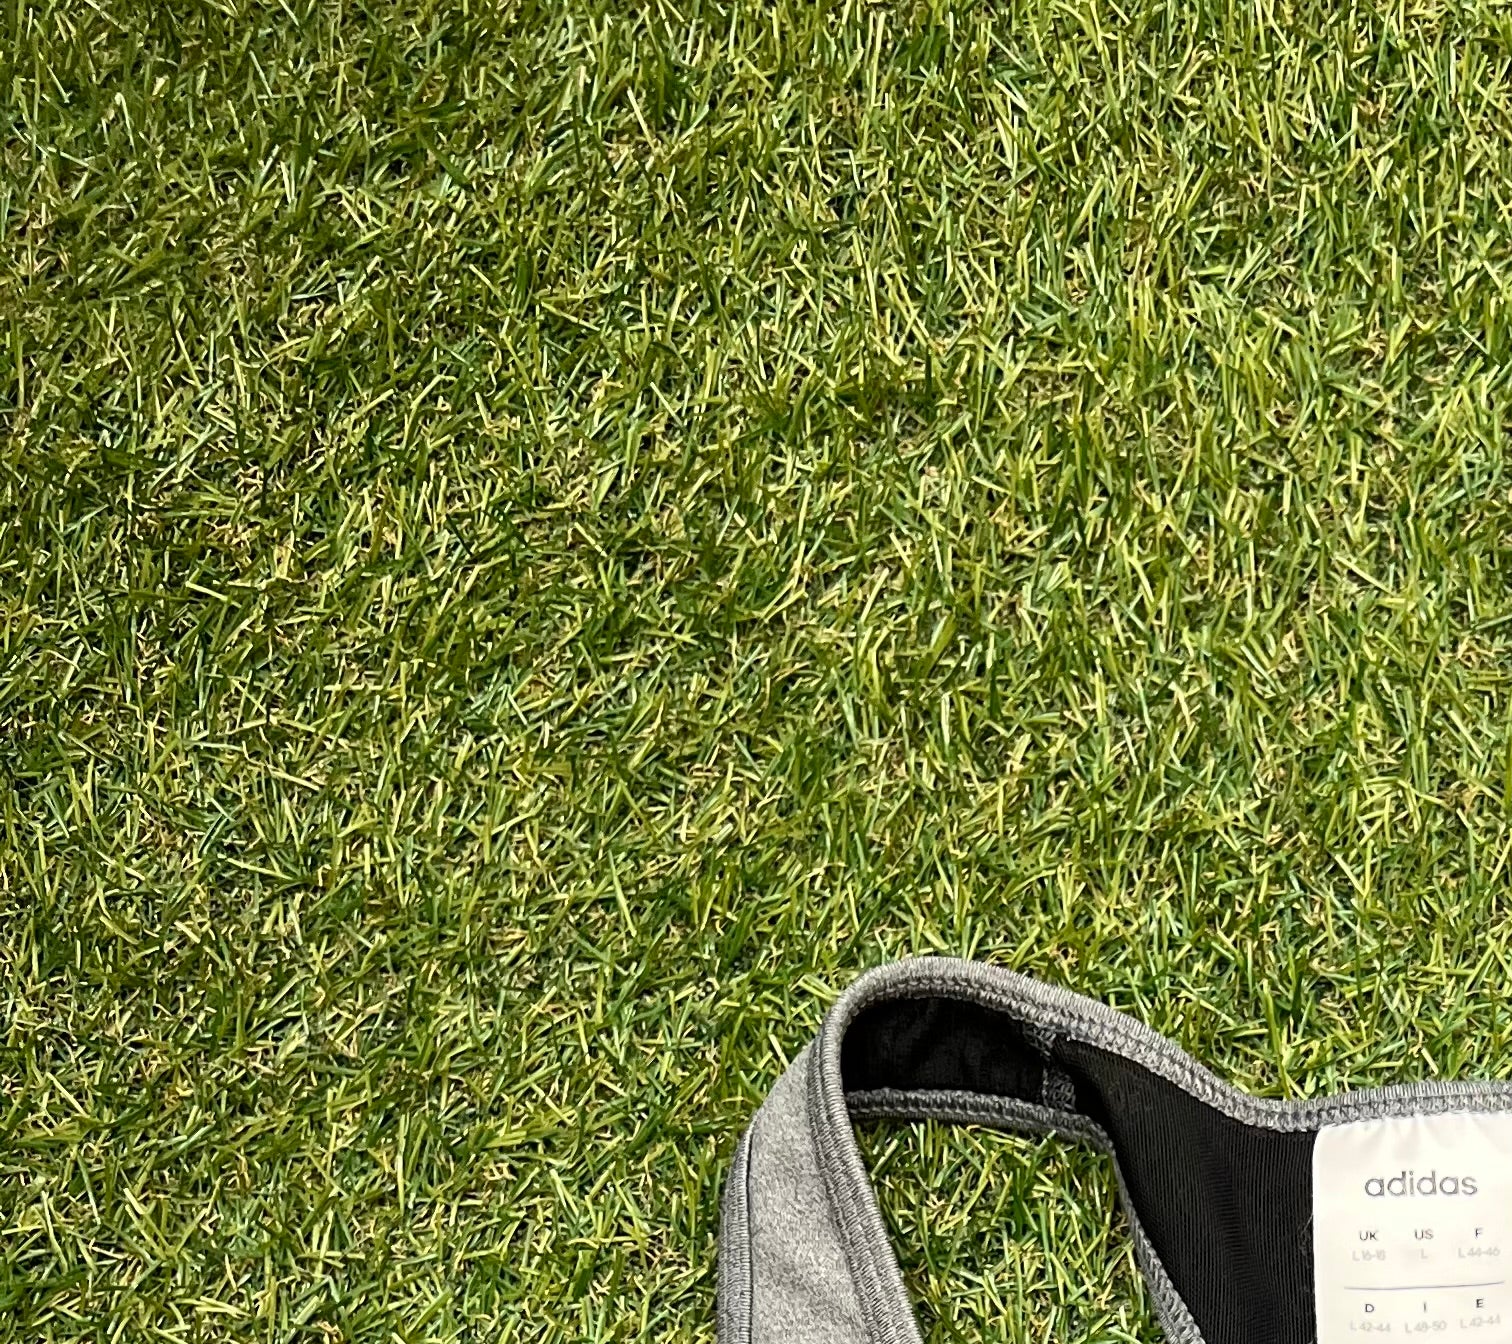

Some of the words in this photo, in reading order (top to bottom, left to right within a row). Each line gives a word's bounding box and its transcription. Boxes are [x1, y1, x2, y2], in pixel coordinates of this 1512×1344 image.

[1364, 1170, 1478, 1197] adidas
[1359, 1230, 1378, 1242] UK
[1415, 1229, 1434, 1240] US
[1474, 1227, 1483, 1239] F
[1420, 1249, 1428, 1260] L
[1365, 1303, 1375, 1313] D
[1475, 1298, 1484, 1309] E
